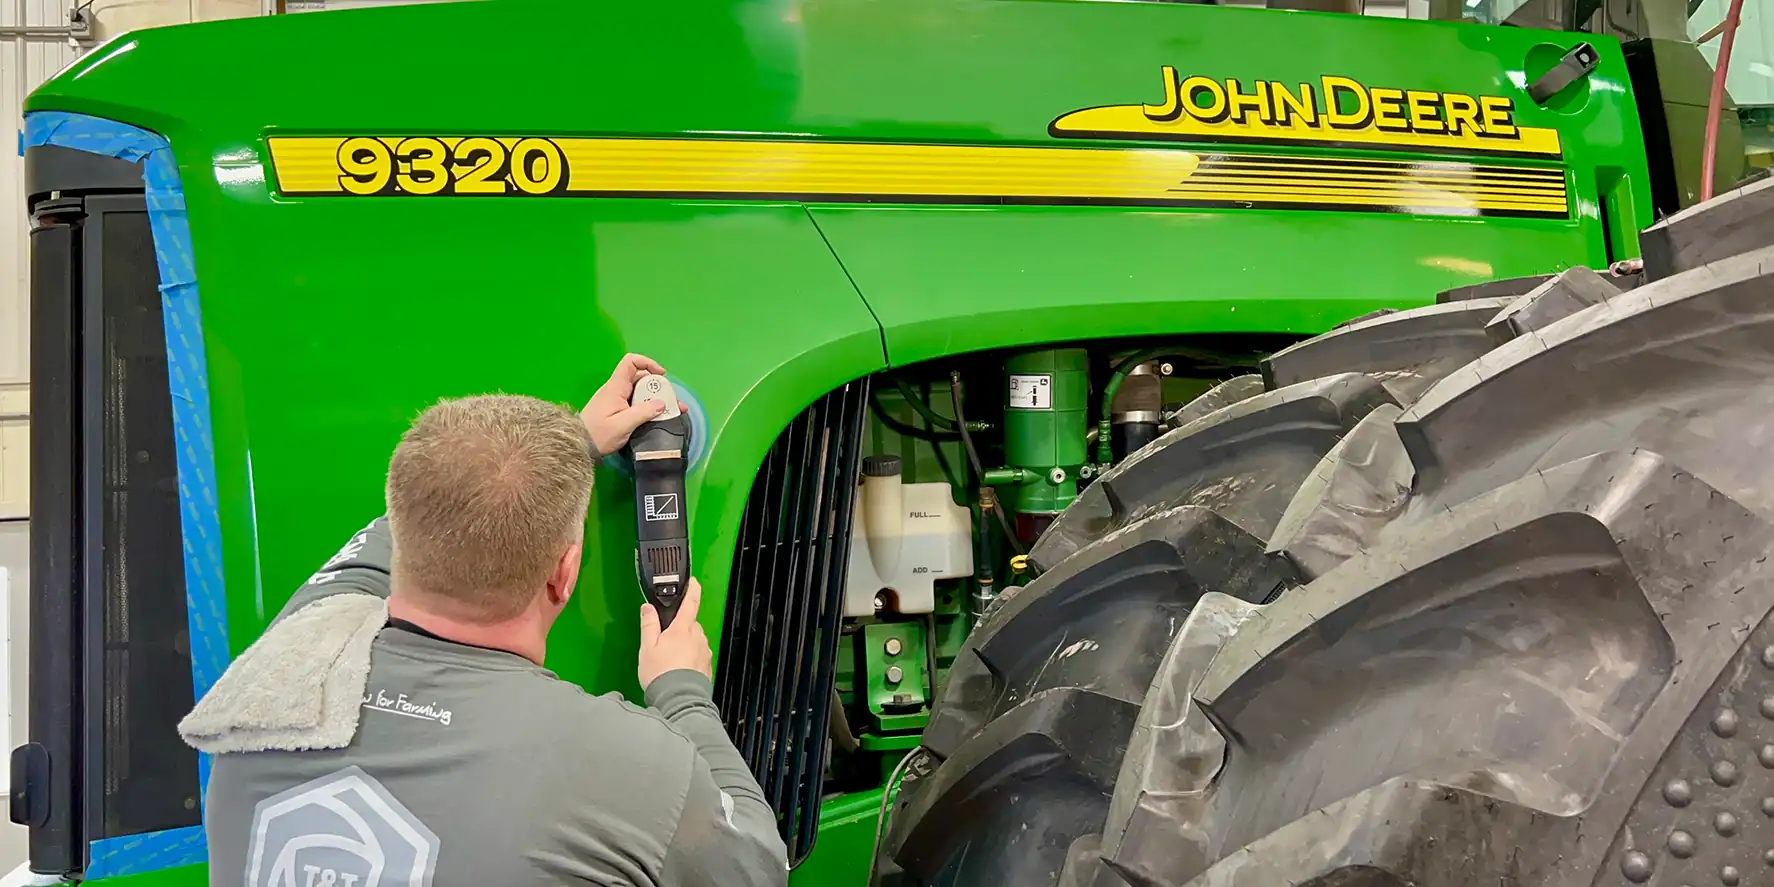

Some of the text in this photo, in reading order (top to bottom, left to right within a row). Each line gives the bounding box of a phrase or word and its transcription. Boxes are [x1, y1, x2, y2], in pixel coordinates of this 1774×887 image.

[1143, 65, 1519, 139] JOHN DEERE
[336, 136, 569, 196] 9320
[649, 382, 659, 390] 15
[375, 688, 395, 707] for
[396, 693, 452, 725] Farming
